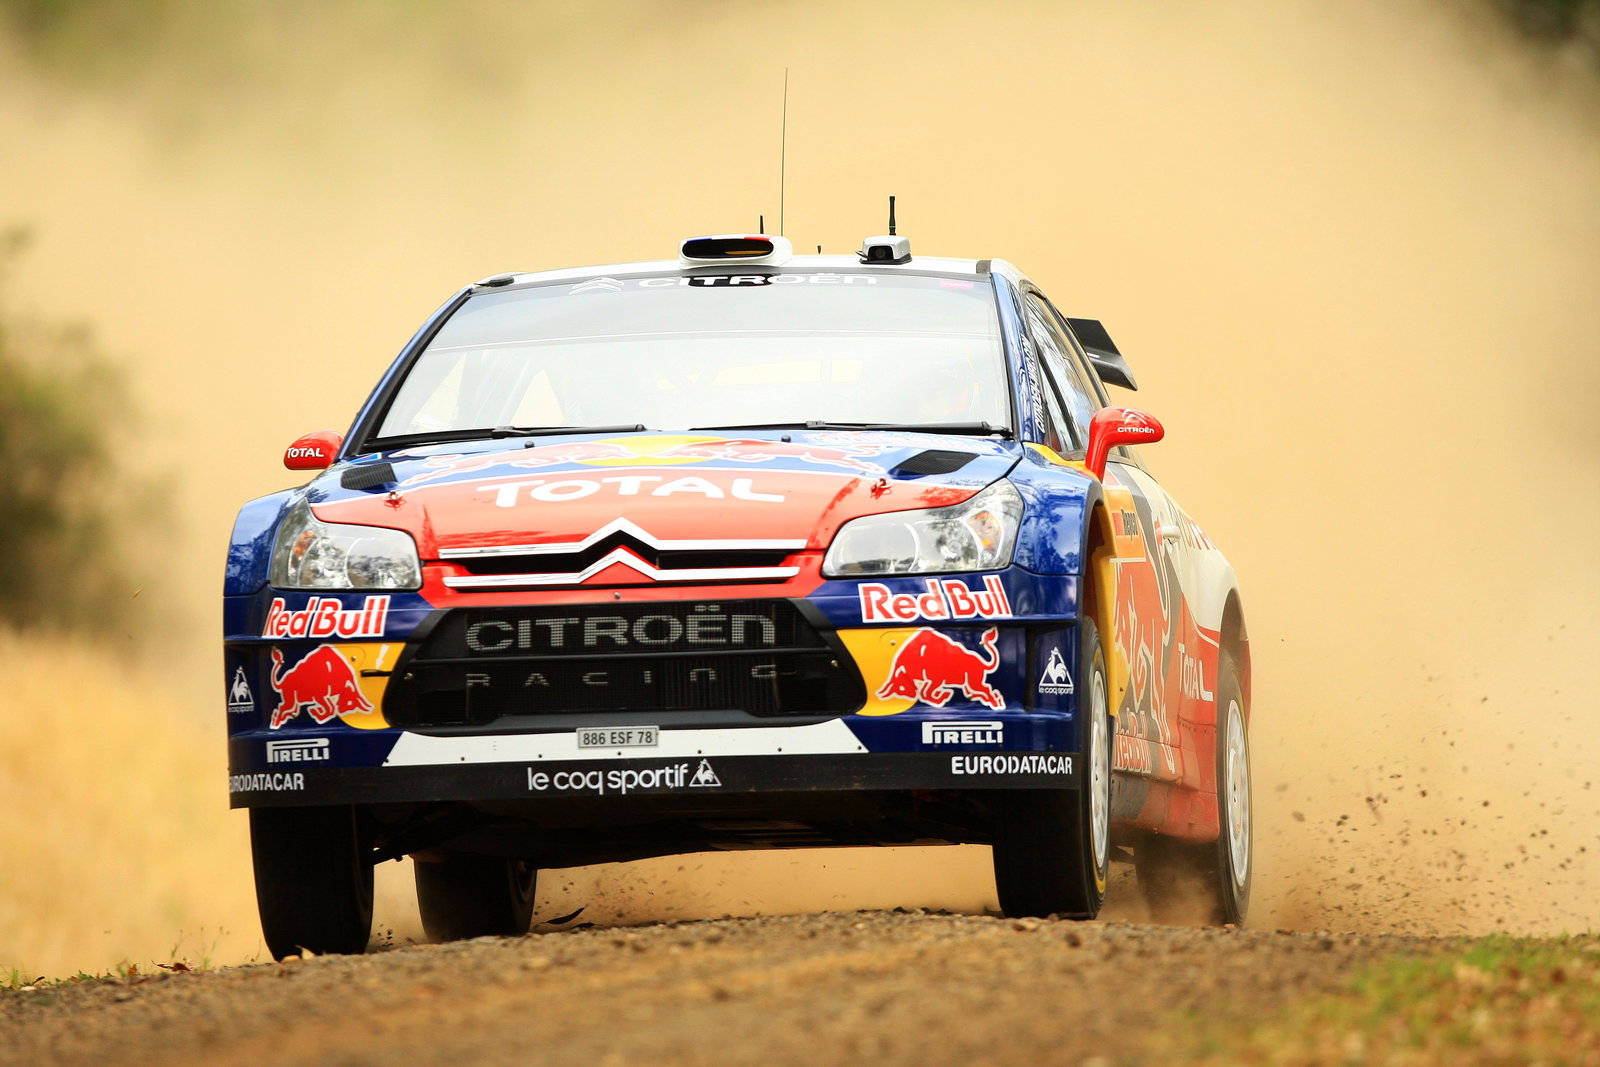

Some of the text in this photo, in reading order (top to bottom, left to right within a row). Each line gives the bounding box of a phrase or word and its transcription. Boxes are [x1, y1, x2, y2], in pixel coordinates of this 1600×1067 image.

[286, 447, 325, 459] TOTAL
[477, 476, 785, 508] TOTAL
[858, 575, 1013, 623] Red Bull
[262, 595, 391, 638] Red Bull
[1178, 642, 1214, 702] TOTAL
[583, 731, 653, 745] 886 ESF 78
[922, 721, 1004, 744] PIRELLI
[266, 738, 330, 763] PIRELLI
[527, 763, 688, 795] le coq sportif
[951, 756, 1073, 775] EURODATACAR
